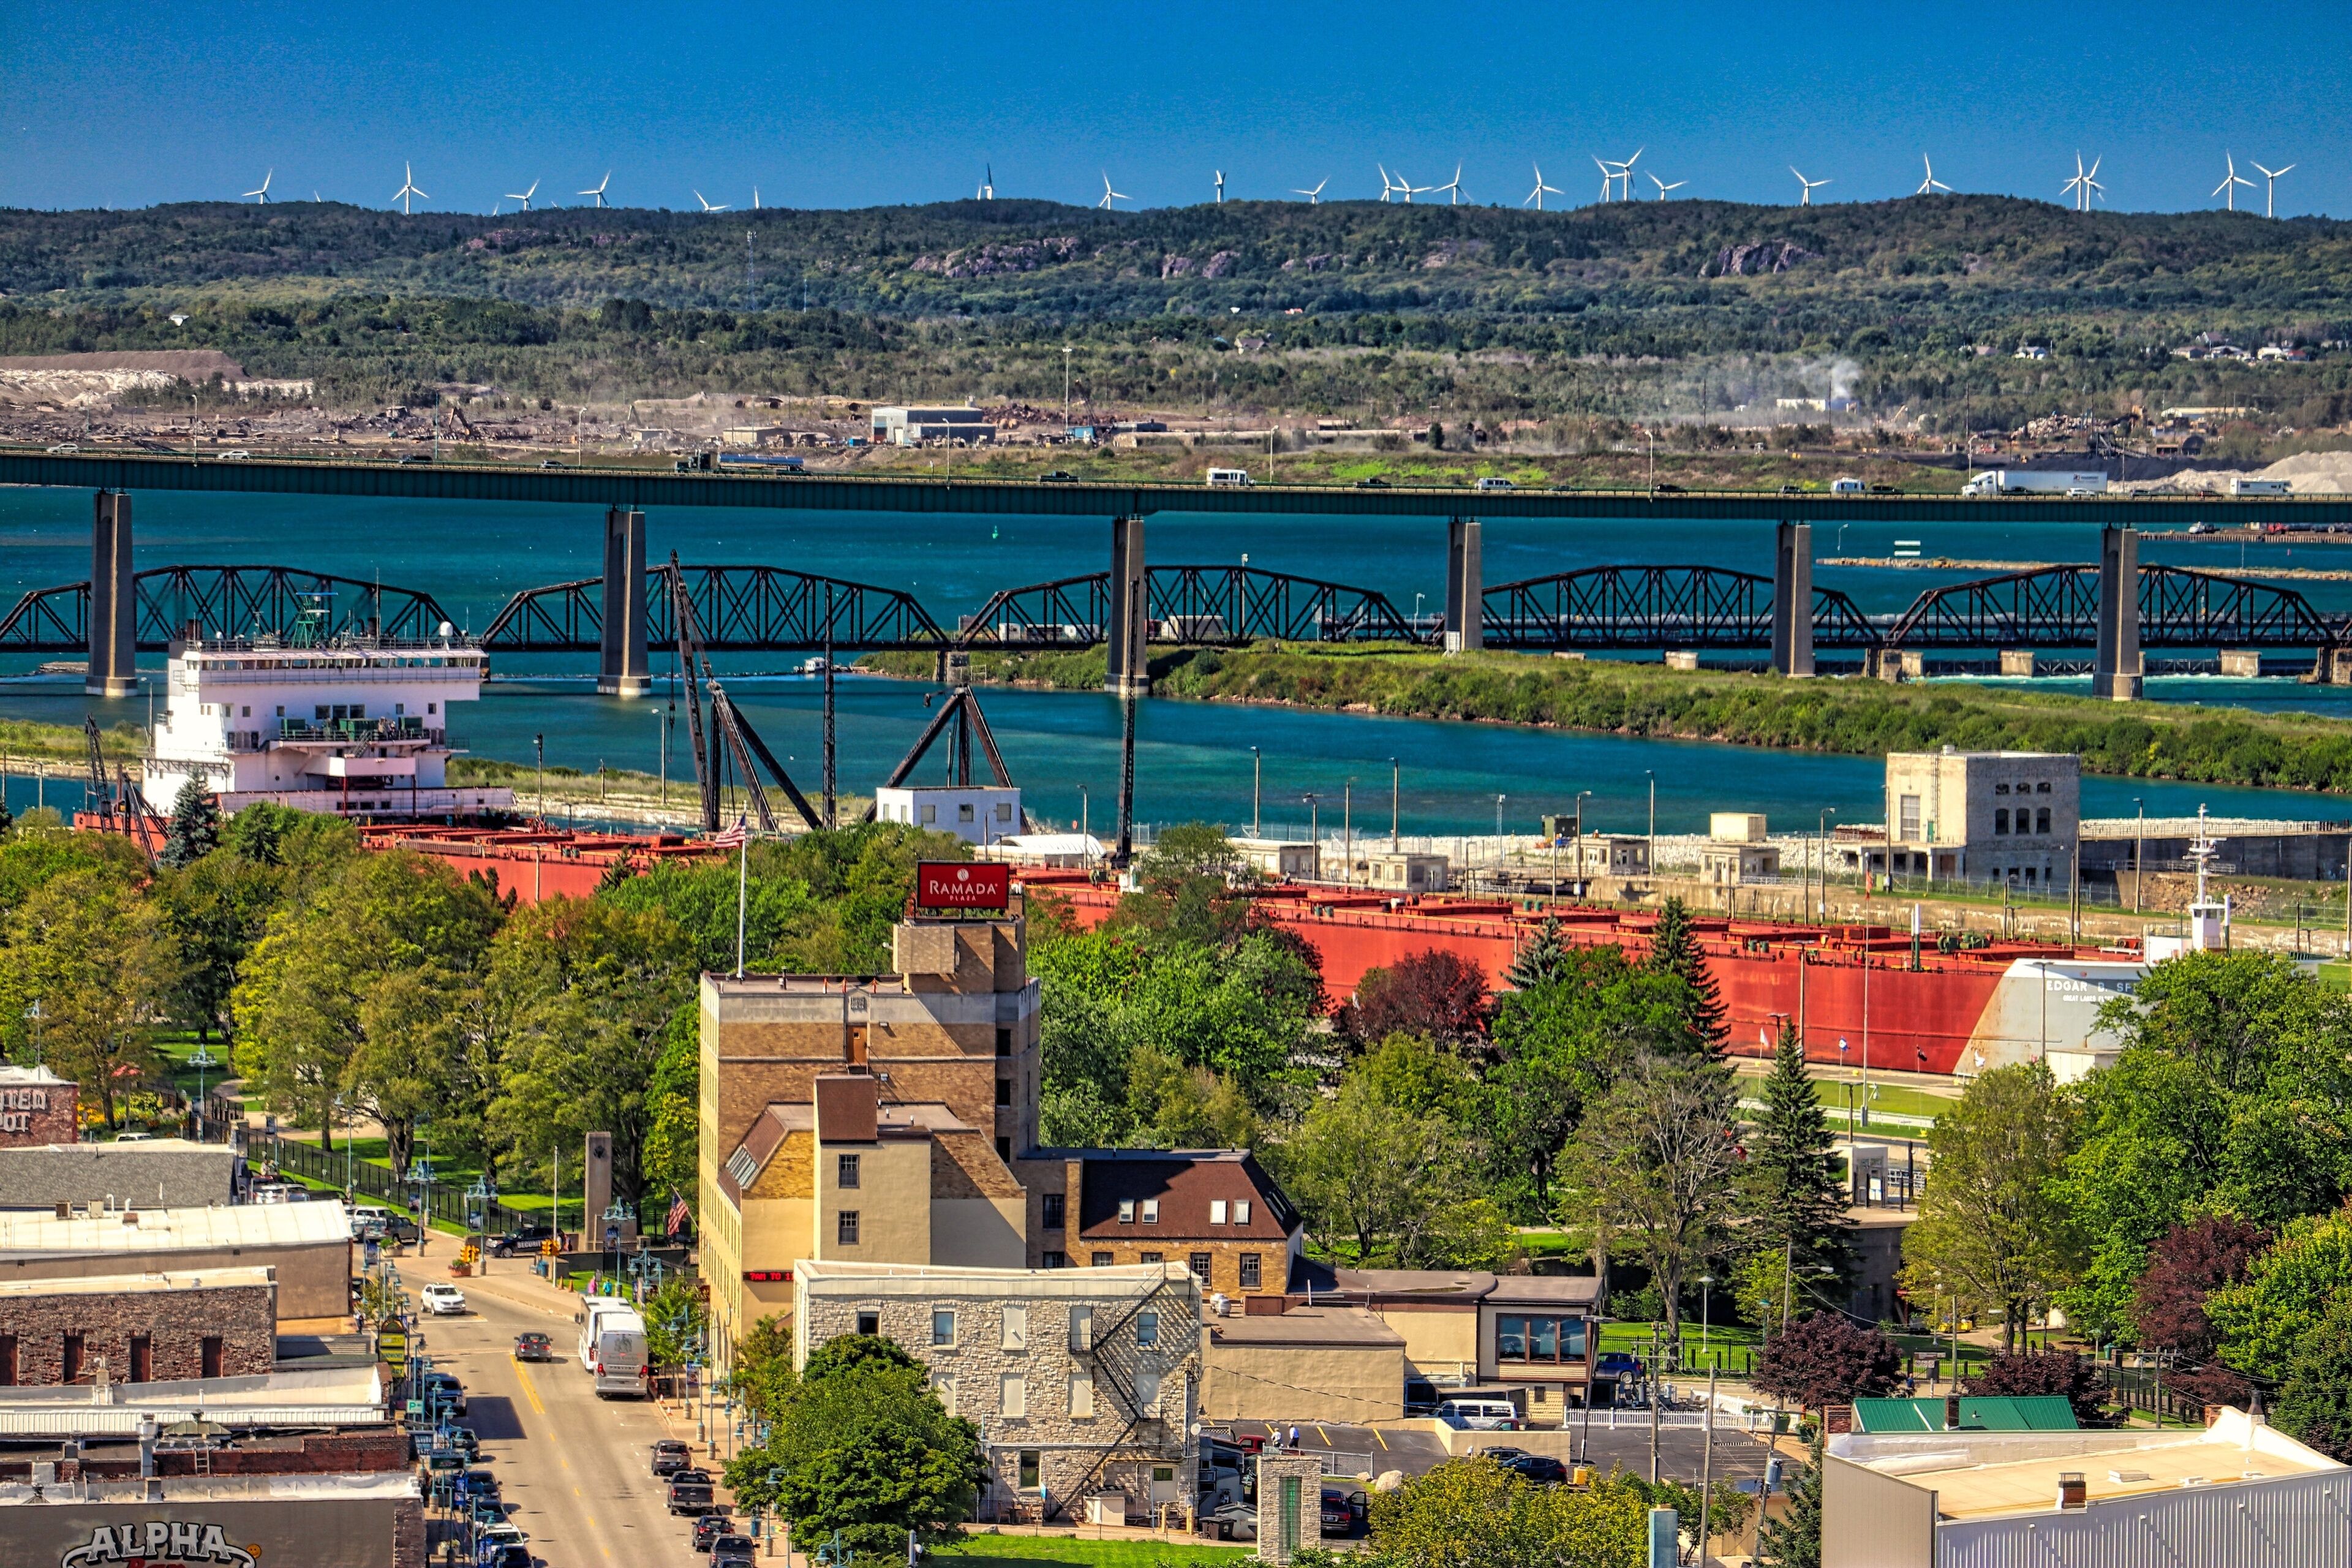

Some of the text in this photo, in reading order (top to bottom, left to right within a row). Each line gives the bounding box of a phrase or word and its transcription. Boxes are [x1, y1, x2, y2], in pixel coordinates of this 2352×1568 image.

[929, 880, 997, 895] RAMADA
[2046, 980, 2132, 992] EDGAR B. SP
[0, 1088, 47, 1110] TED
[0, 1111, 31, 1133] OT
[517, 1240, 541, 1249] SECURIT
[409, 1402, 416, 1411] P
[85, 1521, 232, 1562] ALPHA
